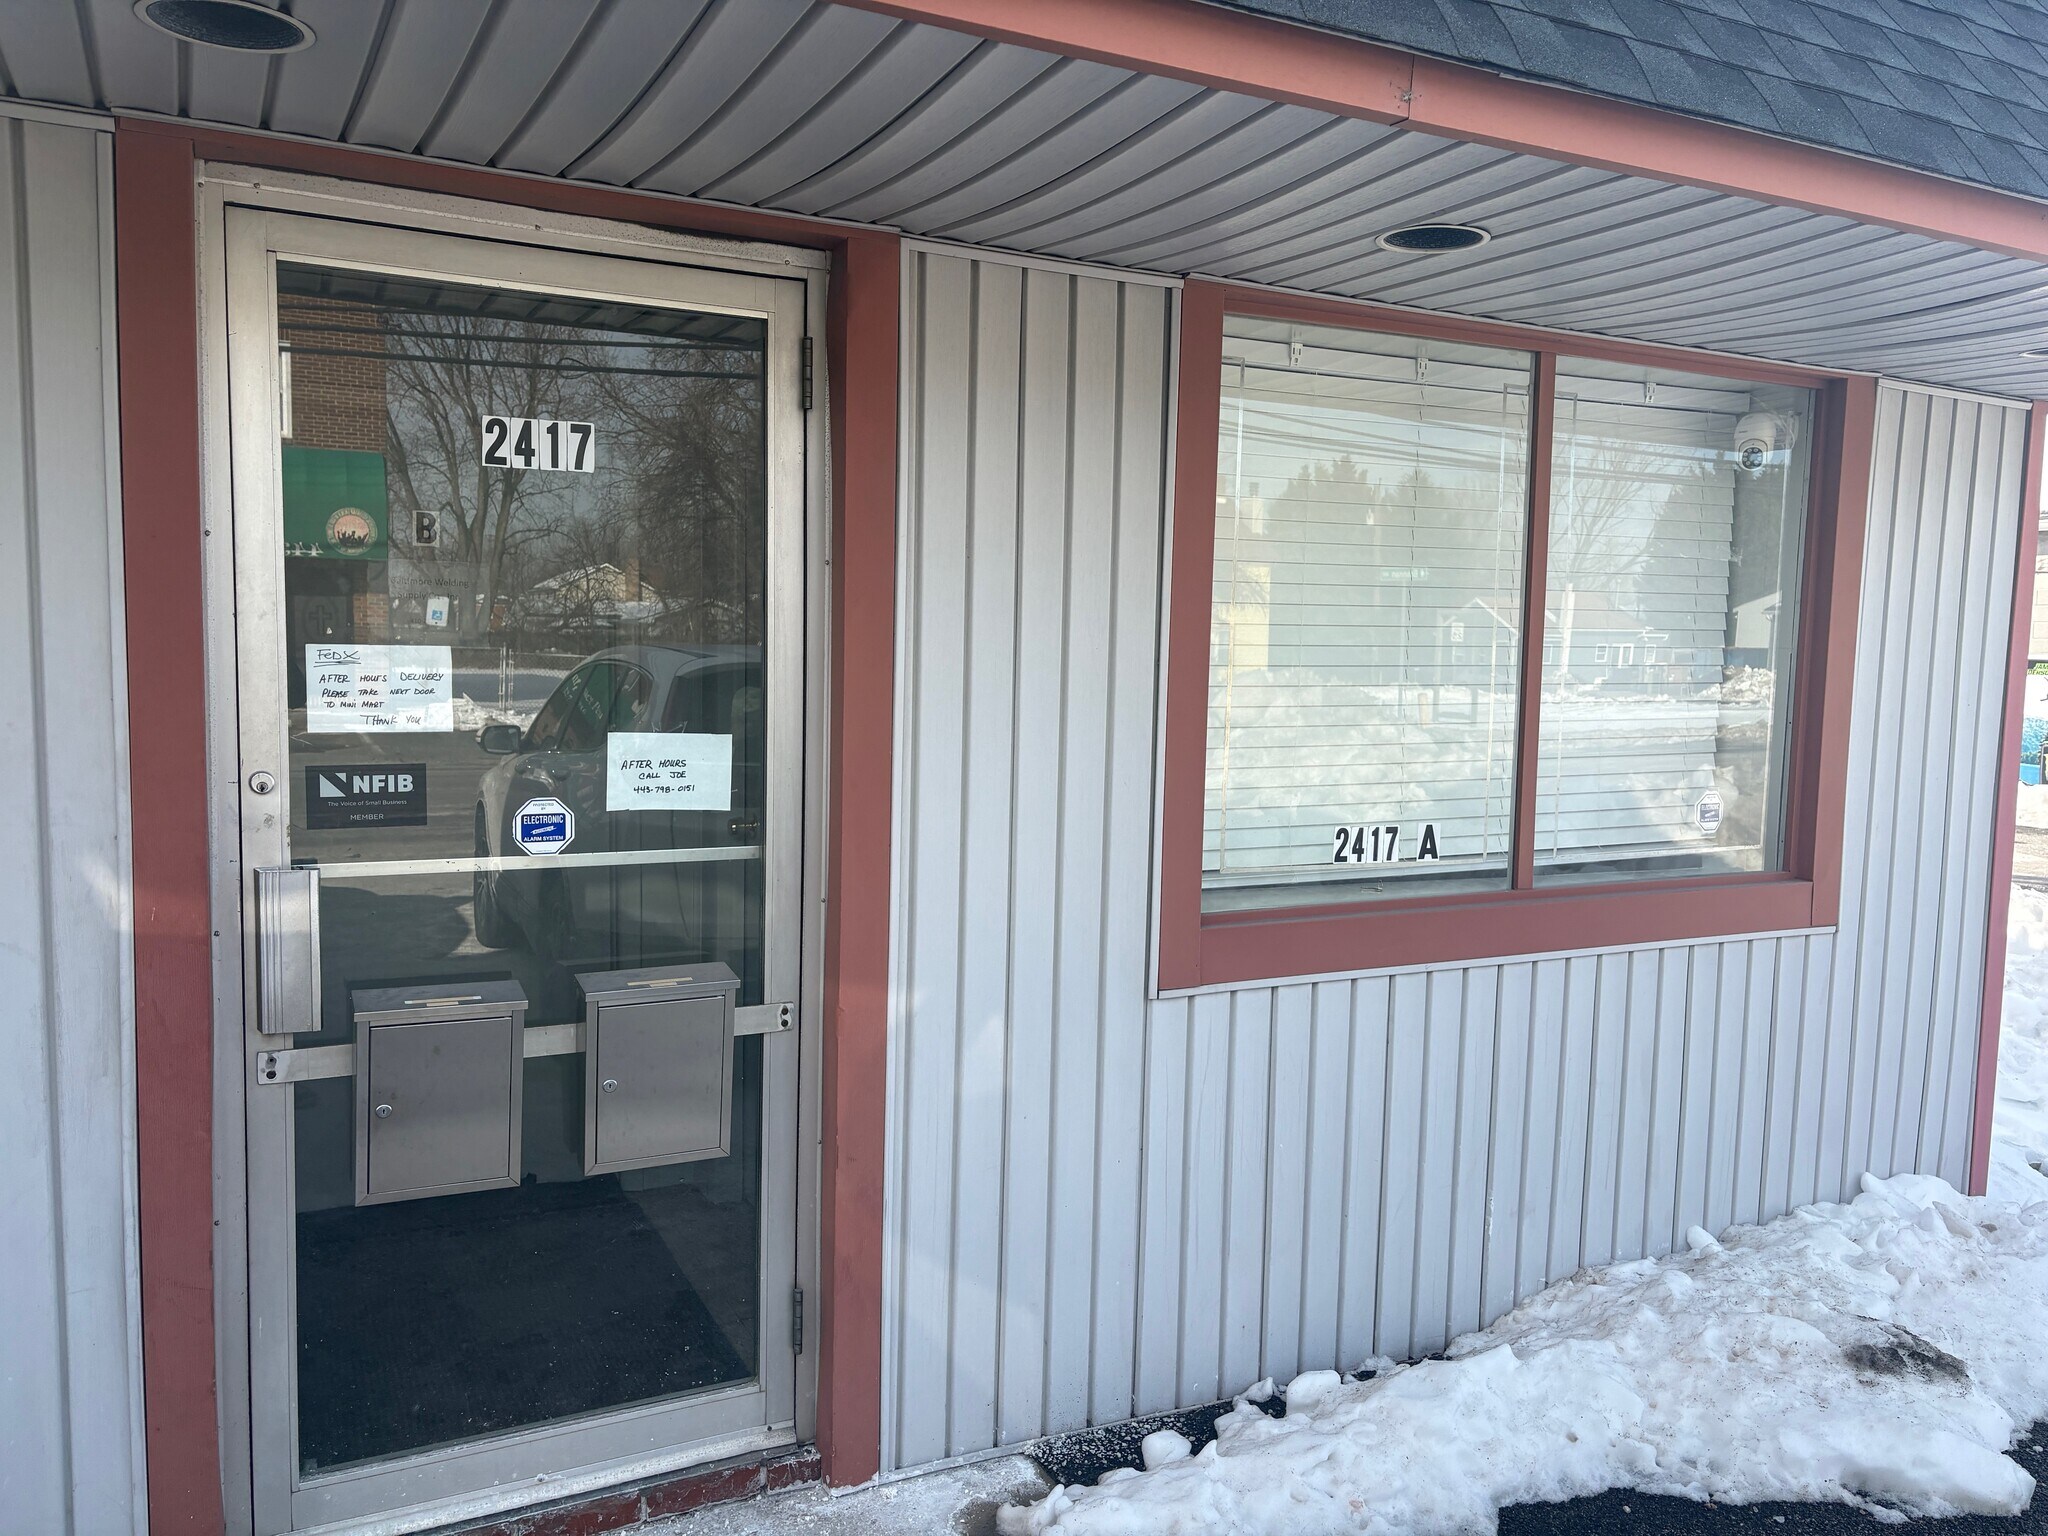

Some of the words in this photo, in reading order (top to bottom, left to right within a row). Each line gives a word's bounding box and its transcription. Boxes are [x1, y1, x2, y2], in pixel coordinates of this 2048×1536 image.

[484, 417, 593, 471] 2417
[416, 512, 437, 543] B
[435, 578, 470, 589] Welding
[319, 674, 350, 684] AFTER
[400, 672, 444, 681] DELIVERY
[322, 688, 350, 698] PLEASE
[360, 714, 398, 726] THANK
[406, 715, 421, 725] YOU
[621, 760, 653, 771] AFTER
[658, 760, 687, 768] HOURS
[638, 772, 661, 780] CALL
[669, 771, 687, 779] JOE
[352, 774, 415, 794] NFIB
[350, 813, 384, 821] MEMBER
[523, 814, 564, 825] ELECTRONIC
[1333, 826, 1399, 863] 2417
[1417, 824, 1439, 860] A
